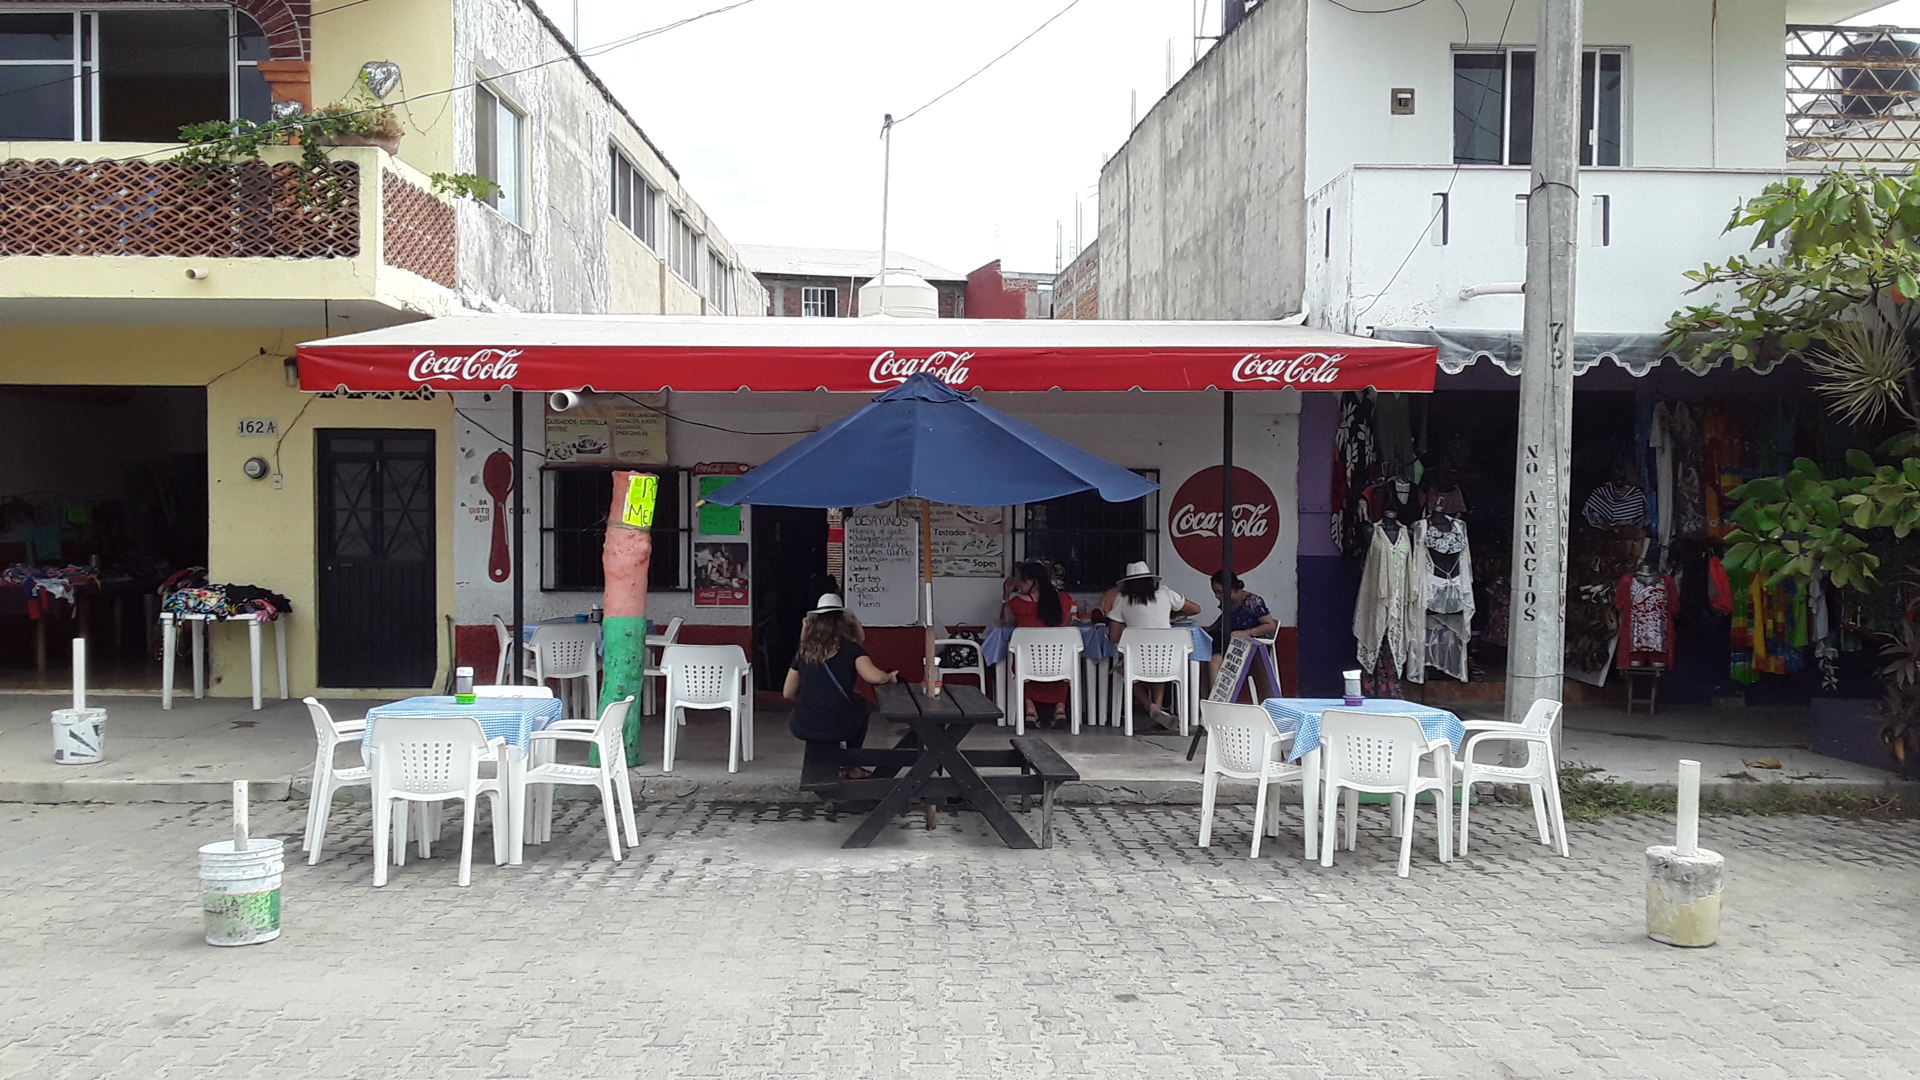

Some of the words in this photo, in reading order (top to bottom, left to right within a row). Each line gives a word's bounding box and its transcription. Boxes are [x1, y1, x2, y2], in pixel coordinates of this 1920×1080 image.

[408, 348, 525, 382] Coca-Cola
[868, 350, 977, 385] Coca-Cola
[1231, 352, 1349, 384] Coca-Cola
[1526, 444, 1539, 475] NO
[855, 516, 909, 527] DESAYUNOS
[972, 559, 997, 568] Sopes
[1524, 490, 1538, 622] ANUNCIOS
